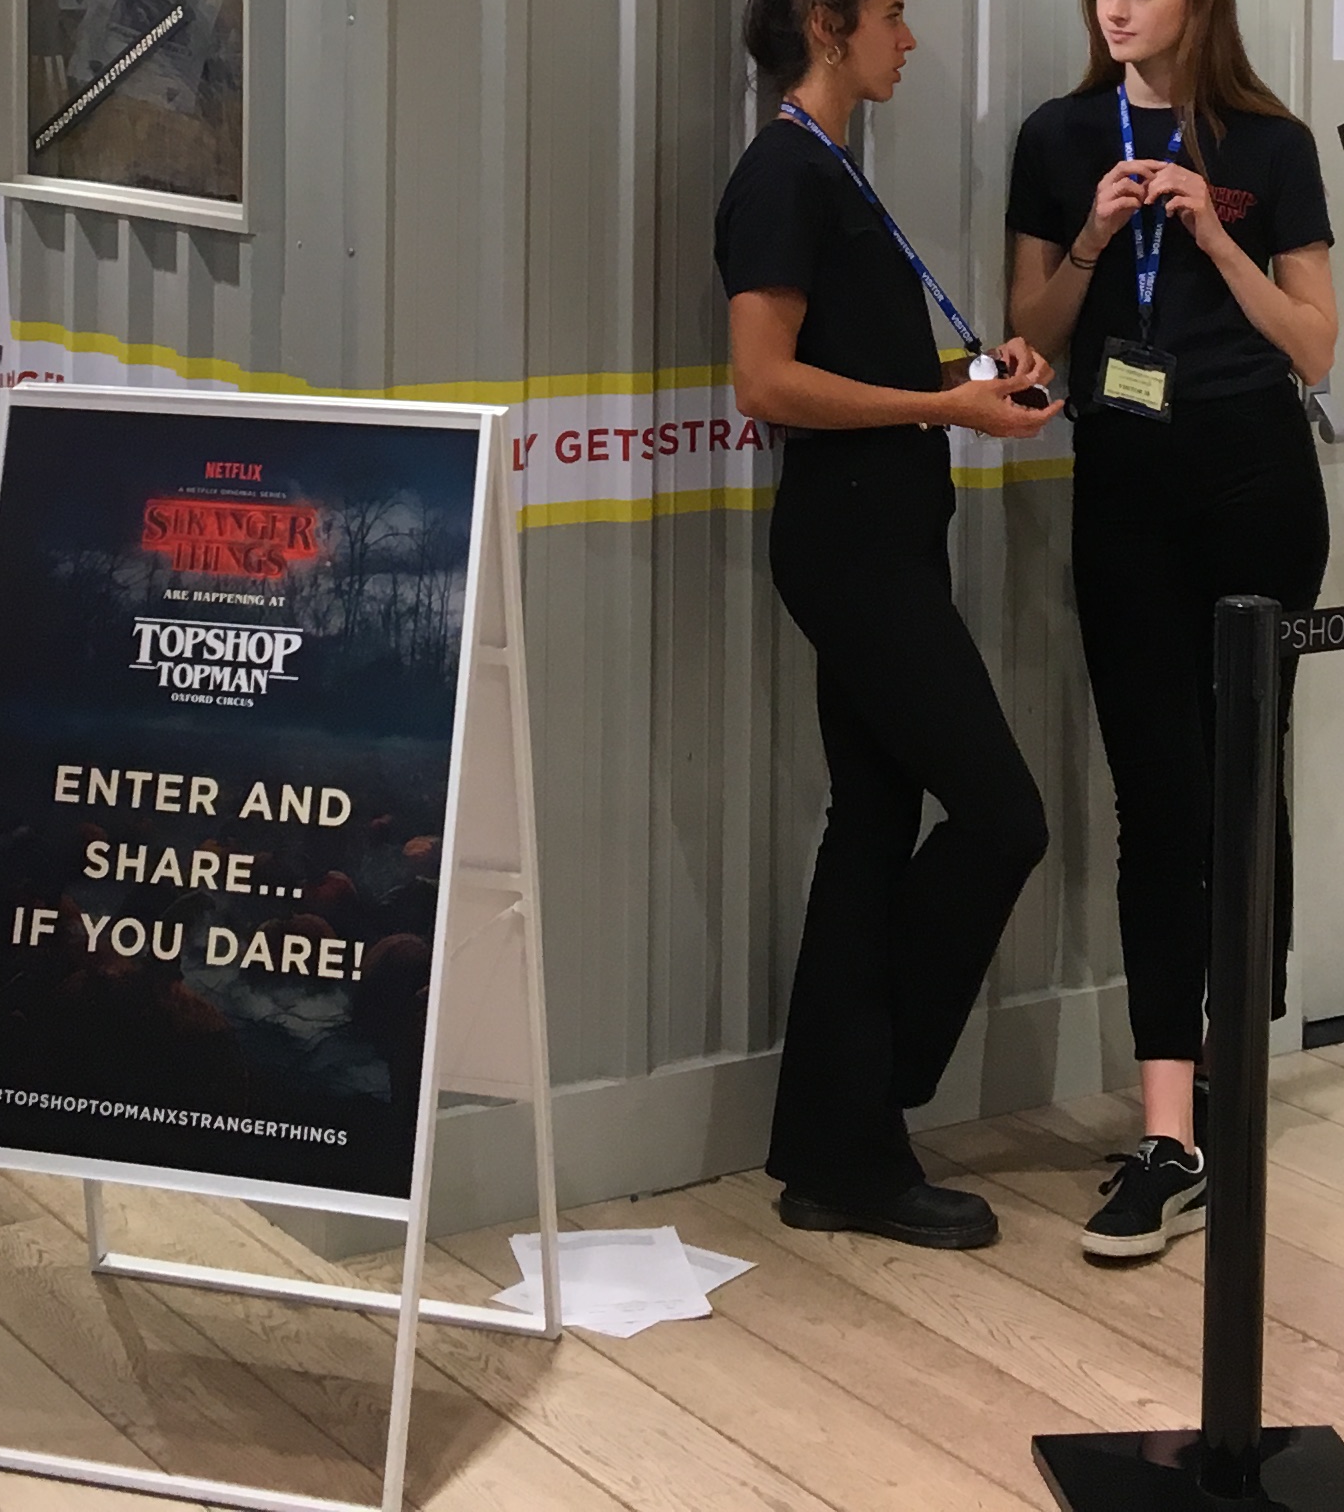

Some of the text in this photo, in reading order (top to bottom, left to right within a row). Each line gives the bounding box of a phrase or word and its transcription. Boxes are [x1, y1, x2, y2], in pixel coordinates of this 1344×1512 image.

[1150, 222, 1164, 256] VISITOR
[922, 271, 945, 302] VISITOR
[1143, 270, 1157, 303] VISITOR
[950, 313, 974, 343] VISITOR
[554, 426, 654, 465] GETS
[205, 461, 263, 482] NETFLIX
[143, 501, 318, 552] STRANGER
[173, 542, 287, 578] THINGS
[163, 589, 287, 607] ARE HAPPENING AT
[132, 622, 303, 674] TOPSHOP
[156, 661, 269, 695] TOPMAN
[171, 692, 254, 708] OXFORD CIRCUS
[55, 765, 352, 827] ENTER AND
[83, 840, 303, 899] SHARE...
[11, 907, 365, 981] IF YOU DARE!
